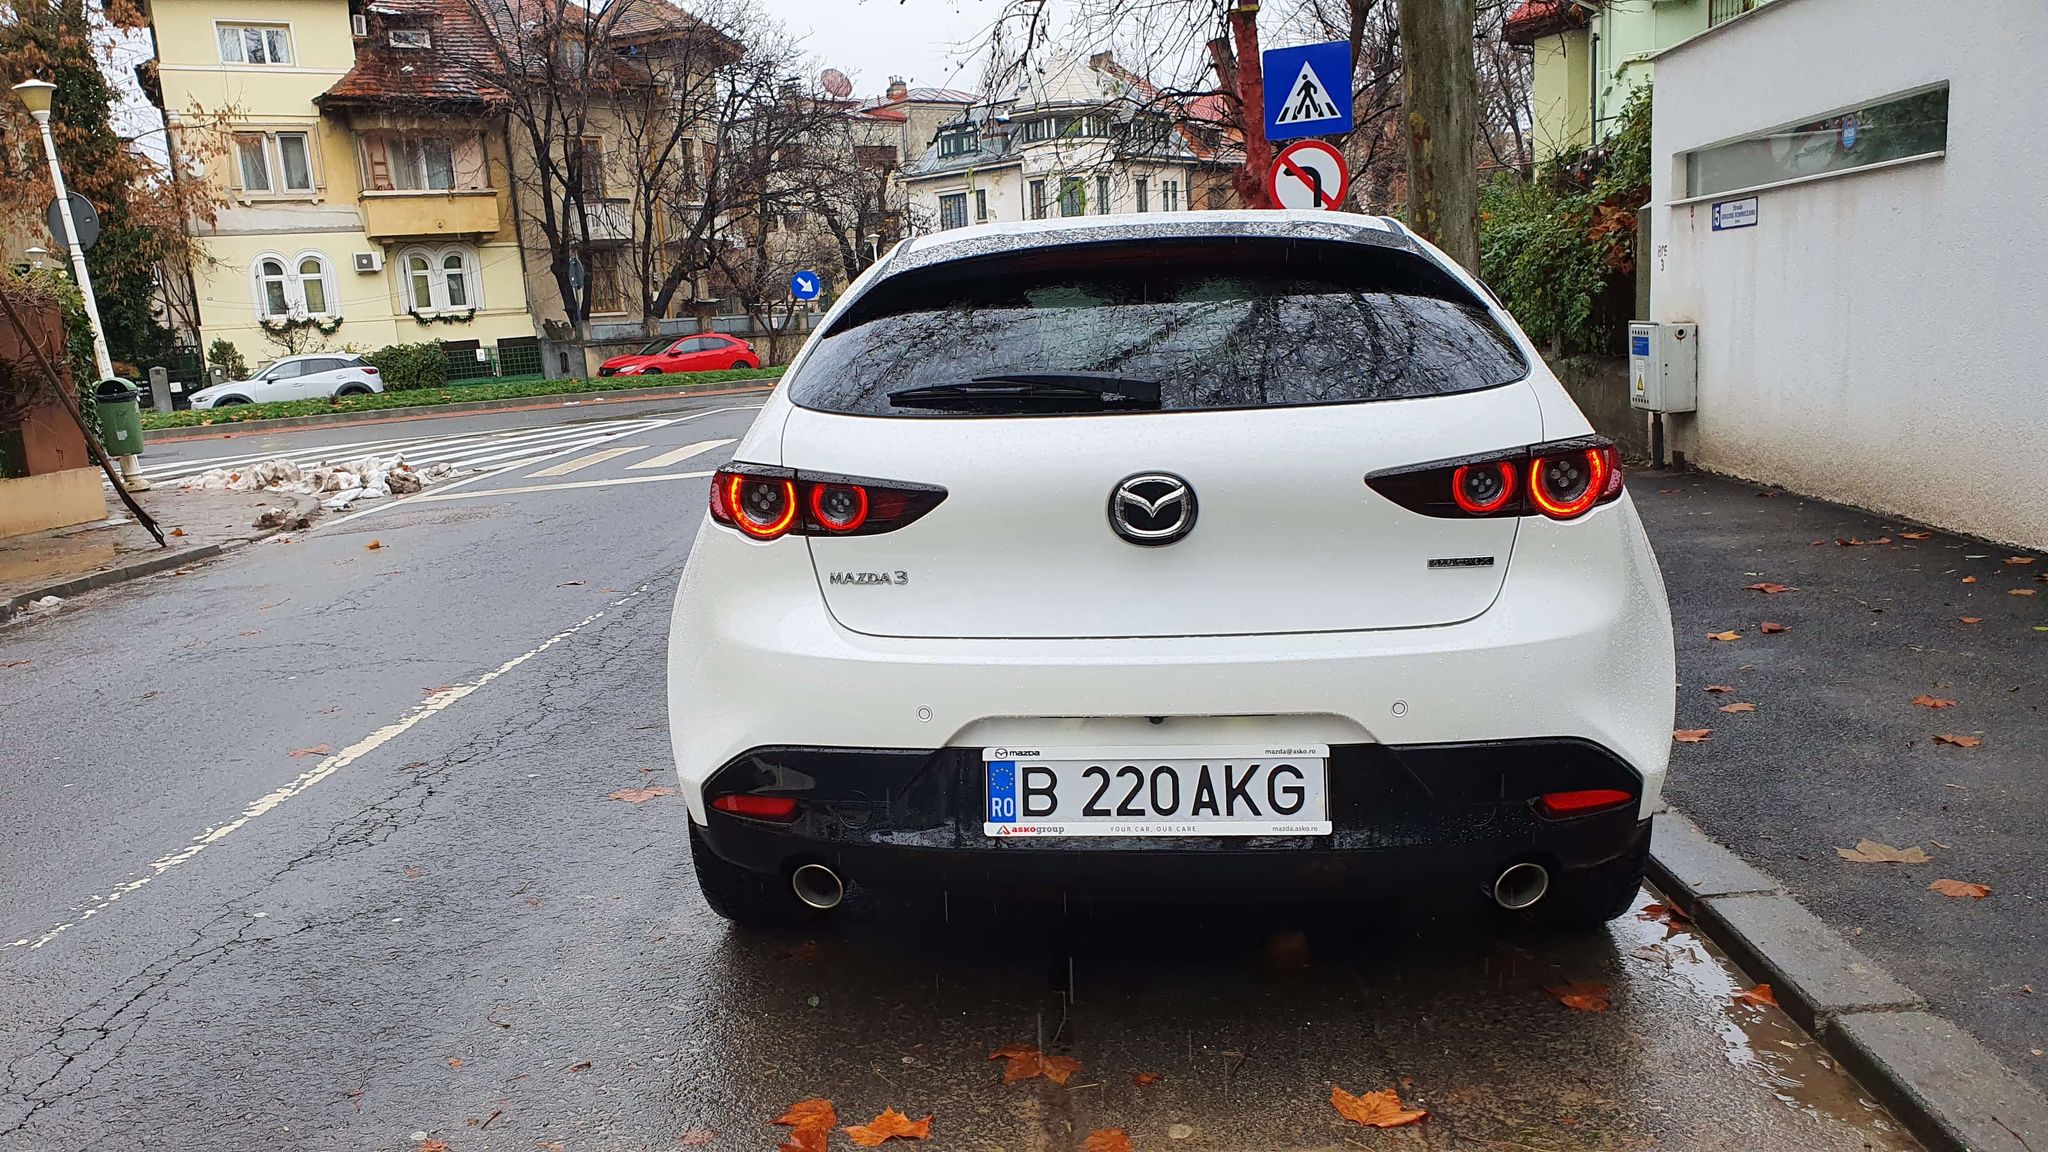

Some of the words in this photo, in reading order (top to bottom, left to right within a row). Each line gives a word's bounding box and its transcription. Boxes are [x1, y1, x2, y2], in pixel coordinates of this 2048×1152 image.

[829, 572, 893, 585] MAZDA
[894, 570, 909, 585] 3
[1022, 766, 1058, 816] B
[1082, 765, 1180, 816] 220
[1191, 764, 1305, 816] AKG
[991, 797, 1014, 817] RO
